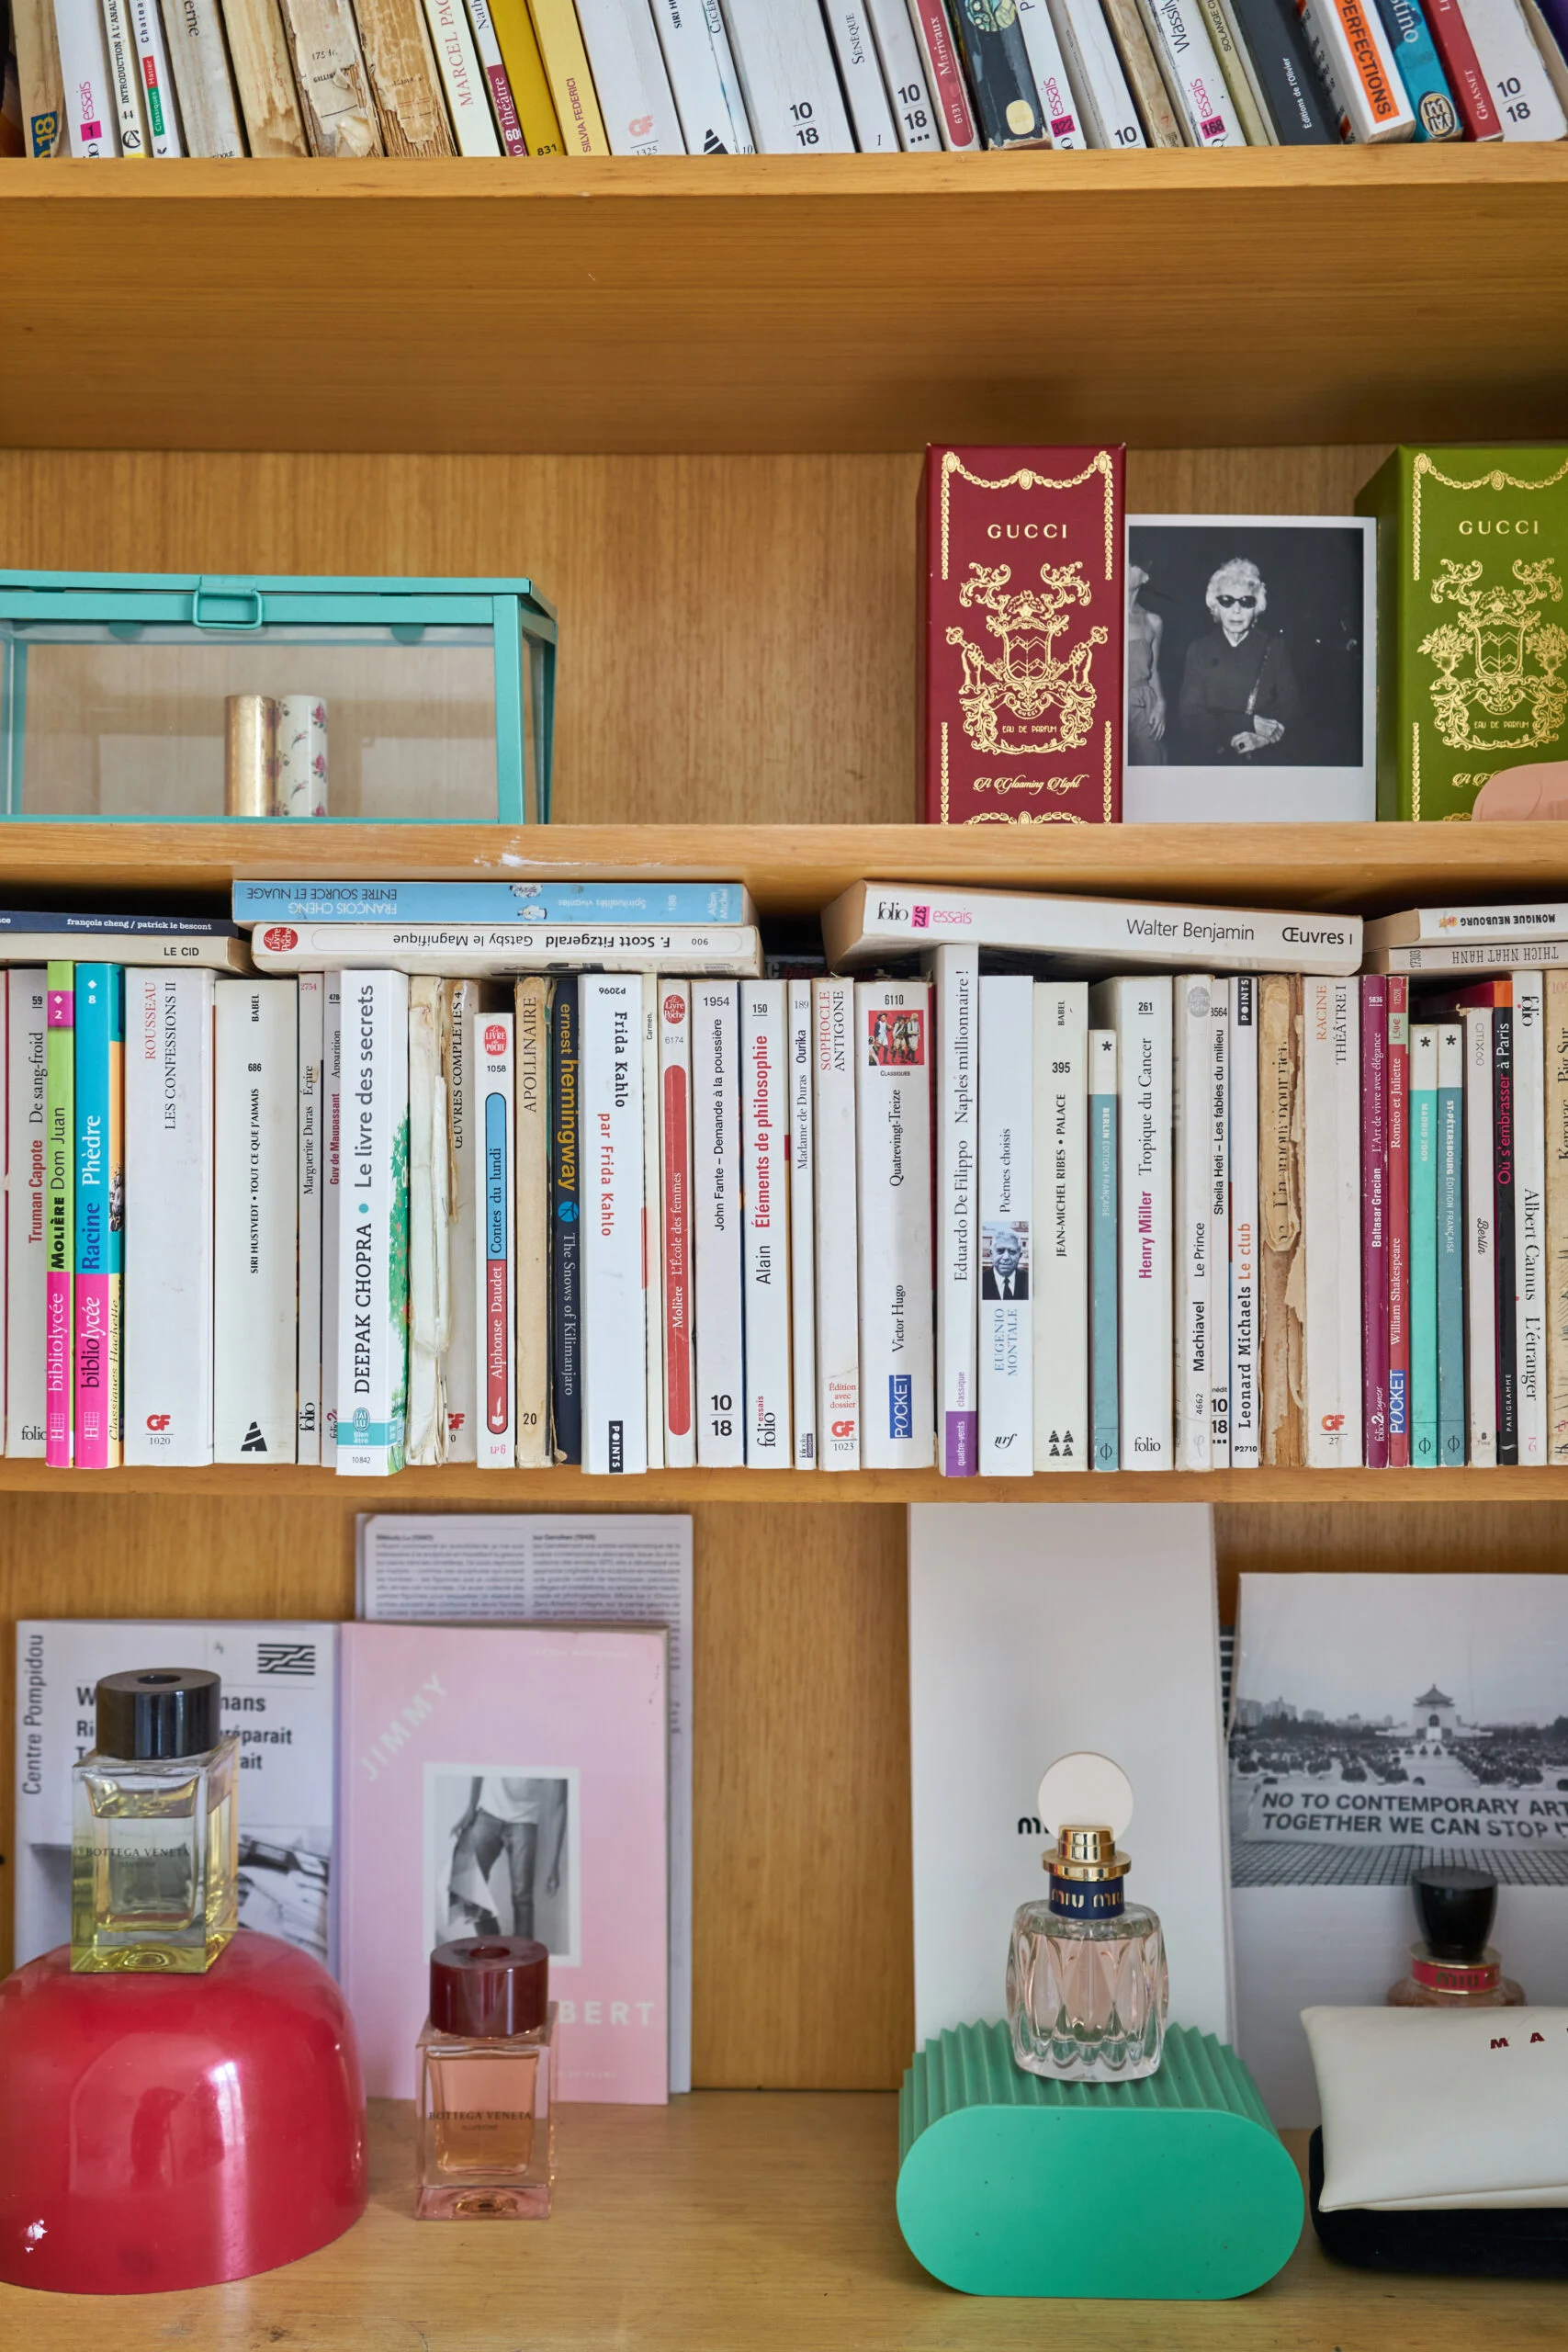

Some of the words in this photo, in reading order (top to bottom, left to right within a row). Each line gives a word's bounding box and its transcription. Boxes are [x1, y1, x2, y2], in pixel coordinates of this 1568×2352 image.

[931, 17, 951, 77] Marivaux
[1211, 10, 1231, 52] SOLANGE
[114, 41, 130, 104] INTRODUCTION
[447, 31, 474, 107] MARCEL
[1496, 77, 1520, 97] 10
[79, 81, 94, 120] essais
[151, 91, 162, 131] Classiques
[493, 77, 514, 125] théâtre
[566, 77, 583, 120] FEDERICI
[790, 102, 813, 121] 10
[897, 84, 920, 104] 10
[1041, 77, 1064, 117] essais
[1464, 69, 1487, 120] GRASSET
[1506, 102, 1530, 122] 18
[578, 121, 592, 153] SILVIA
[796, 127, 819, 146] 18
[904, 109, 927, 130] 18
[536, 143, 558, 156] 831
[987, 524, 1067, 538] GUCCI
[1459, 520, 1539, 535] GUCCI
[1002, 725, 1015, 733] EAU
[1019, 725, 1027, 733] DE
[1032, 725, 1057, 733] PARFUM
[247, 888, 291, 899] NUAGE
[288, 902, 333, 914] CHENG
[310, 888, 358, 899] SOURCE
[336, 901, 397, 915] FRANÇOIS
[361, 888, 397, 899] ENTRE
[877, 901, 908, 921] folio
[933, 907, 972, 924] essais
[104, 920, 129, 929] cheng
[137, 921, 169, 929] patrick
[1126, 919, 1179, 937] Walter
[1183, 921, 1254, 943] Benjamin
[1281, 926, 1344, 944] Œuvres
[1461, 915, 1510, 926] NEUBOURG
[1513, 913, 1555, 924] MONIQUE
[164, 947, 177, 956] LE
[181, 947, 199, 956] CID
[393, 933, 468, 946] Magnifique
[490, 933, 533, 946] Gatsby
[546, 933, 615, 948] Fitzgerald
[619, 936, 655, 947] Scott
[1451, 950, 1483, 964] HANH
[1488, 948, 1519, 962] NHAT
[1523, 946, 1559, 960] THICH
[144, 982, 156, 1060] ROUSSEAU
[356, 985, 373, 1061] secrets
[559, 1003, 571, 1054] ernest
[615, 1012, 627, 1054] Frida
[819, 991, 831, 1071] SOPHOCLE
[833, 990, 845, 1071] ANTIGONE
[954, 978, 969, 1070] millionnaire
[1315, 985, 1327, 1041] RACINE
[1333, 994, 1347, 1065] THÉÂTRE
[164, 995, 176, 1099] CONFESSIONS
[523, 997, 536, 1113] APOLLINAIRE
[712, 1019, 726, 1074] poussière
[795, 1030, 807, 1064] Ourika
[1213, 1029, 1224, 1062] milieu
[1496, 1023, 1510, 1056] Paris
[28, 1032, 47, 1100] sang-froid
[752, 1035, 773, 1127] philosophie
[1138, 1038, 1153, 1087] Cancer
[1390, 1058, 1402, 1095] Juliette
[355, 1068, 372, 1105] des
[615, 1061, 627, 1107] Kahlo
[954, 1074, 973, 1124] Naples
[1213, 1084, 1224, 1118] fables
[51, 1107, 65, 1144] Juan
[164, 1102, 176, 1130] LES
[355, 1112, 372, 1157] livre
[557, 1059, 579, 1192] hemingway
[713, 1101, 724, 1154] Demande
[1055, 1094, 1066, 1135] PALACE
[1390, 1111, 1401, 1148] Roméo
[82, 1115, 101, 1186] Phèdre
[797, 1124, 808, 1170] Madame
[888, 1090, 904, 1187] Quatrevingt-Treize
[999, 1128, 1011, 1166] choisis
[1138, 1114, 1156, 1176] Tropique
[28, 1140, 46, 1188] Capote
[51, 1150, 65, 1190] Dom
[303, 1138, 317, 1194] Marguerite
[354, 1164, 372, 1188] Le
[489, 1148, 502, 1180] lundi
[598, 1146, 614, 1184] Frida
[714, 1168, 725, 1200] Fante
[953, 1140, 973, 1192] Filippo
[1055, 1149, 1066, 1179] RIBES
[671, 1172, 682, 1214] femmes
[751, 1157, 770, 1227] Éléments
[1213, 1181, 1224, 1216] Sheila
[1371, 1168, 1382, 1205] Gracian
[28, 1193, 42, 1243] Truman
[714, 1204, 725, 1231] John
[1055, 1183, 1067, 1257] JEAN-MICHEL
[1138, 1191, 1152, 1233] Miller
[82, 1203, 100, 1270] Racine
[953, 1219, 968, 1281] Eduardo
[1193, 1223, 1205, 1260] Prince
[1237, 1223, 1251, 1256] club
[355, 1223, 372, 1307] CHOPRA
[756, 1245, 771, 1284] Alain
[1138, 1237, 1156, 1279] Henry
[1390, 1238, 1403, 1302] Shakespeare
[1524, 1245, 1540, 1300] Camus
[490, 1267, 502, 1312] Daudet
[564, 1261, 576, 1301] Snows
[891, 1284, 906, 1315] Hugo
[671, 1286, 683, 1328] Molière
[1237, 1286, 1251, 1356] Michaels
[1390, 1305, 1401, 1345] William
[48, 1293, 68, 1392] bibliolycée
[81, 1297, 107, 1388] bibliolycée
[354, 1314, 370, 1394] DEEPAK
[491, 1319, 506, 1379] Alphonse
[891, 1318, 904, 1352] Victor
[994, 1308, 1005, 1371] EUGENIO
[1008, 1309, 1019, 1375] MONTALE
[1192, 1301, 1205, 1372] Machiavel
[562, 1322, 577, 1396] Kilimanjaro
[893, 1374, 908, 1438] POCKET
[1237, 1363, 1252, 1429] Leonard
[1390, 1370, 1404, 1433] POCKET
[22, 1634, 47, 1726] Pompidou
[360, 1673, 447, 1782] JIMMY
[21, 1733, 42, 1795] Centre
[1262, 1792, 1294, 1809] NO
[1301, 1793, 1330, 1810] TO
[1337, 1794, 1519, 1815] CONTEMPORARY
[1529, 1800, 1568, 1816] ART
[1262, 1813, 1382, 1833] TOGETHER
[1389, 1815, 1424, 1834] WE
[1430, 1817, 1481, 1836] CAN
[1486, 1819, 1548, 1838] STOP
[86, 1848, 140, 1857] BOTTEGA
[144, 1848, 189, 1857] VENETA
[1052, 1888, 1084, 1908] miu
[429, 2110, 482, 2121] BOTTEGA
[487, 2111, 532, 2120] VENETA
